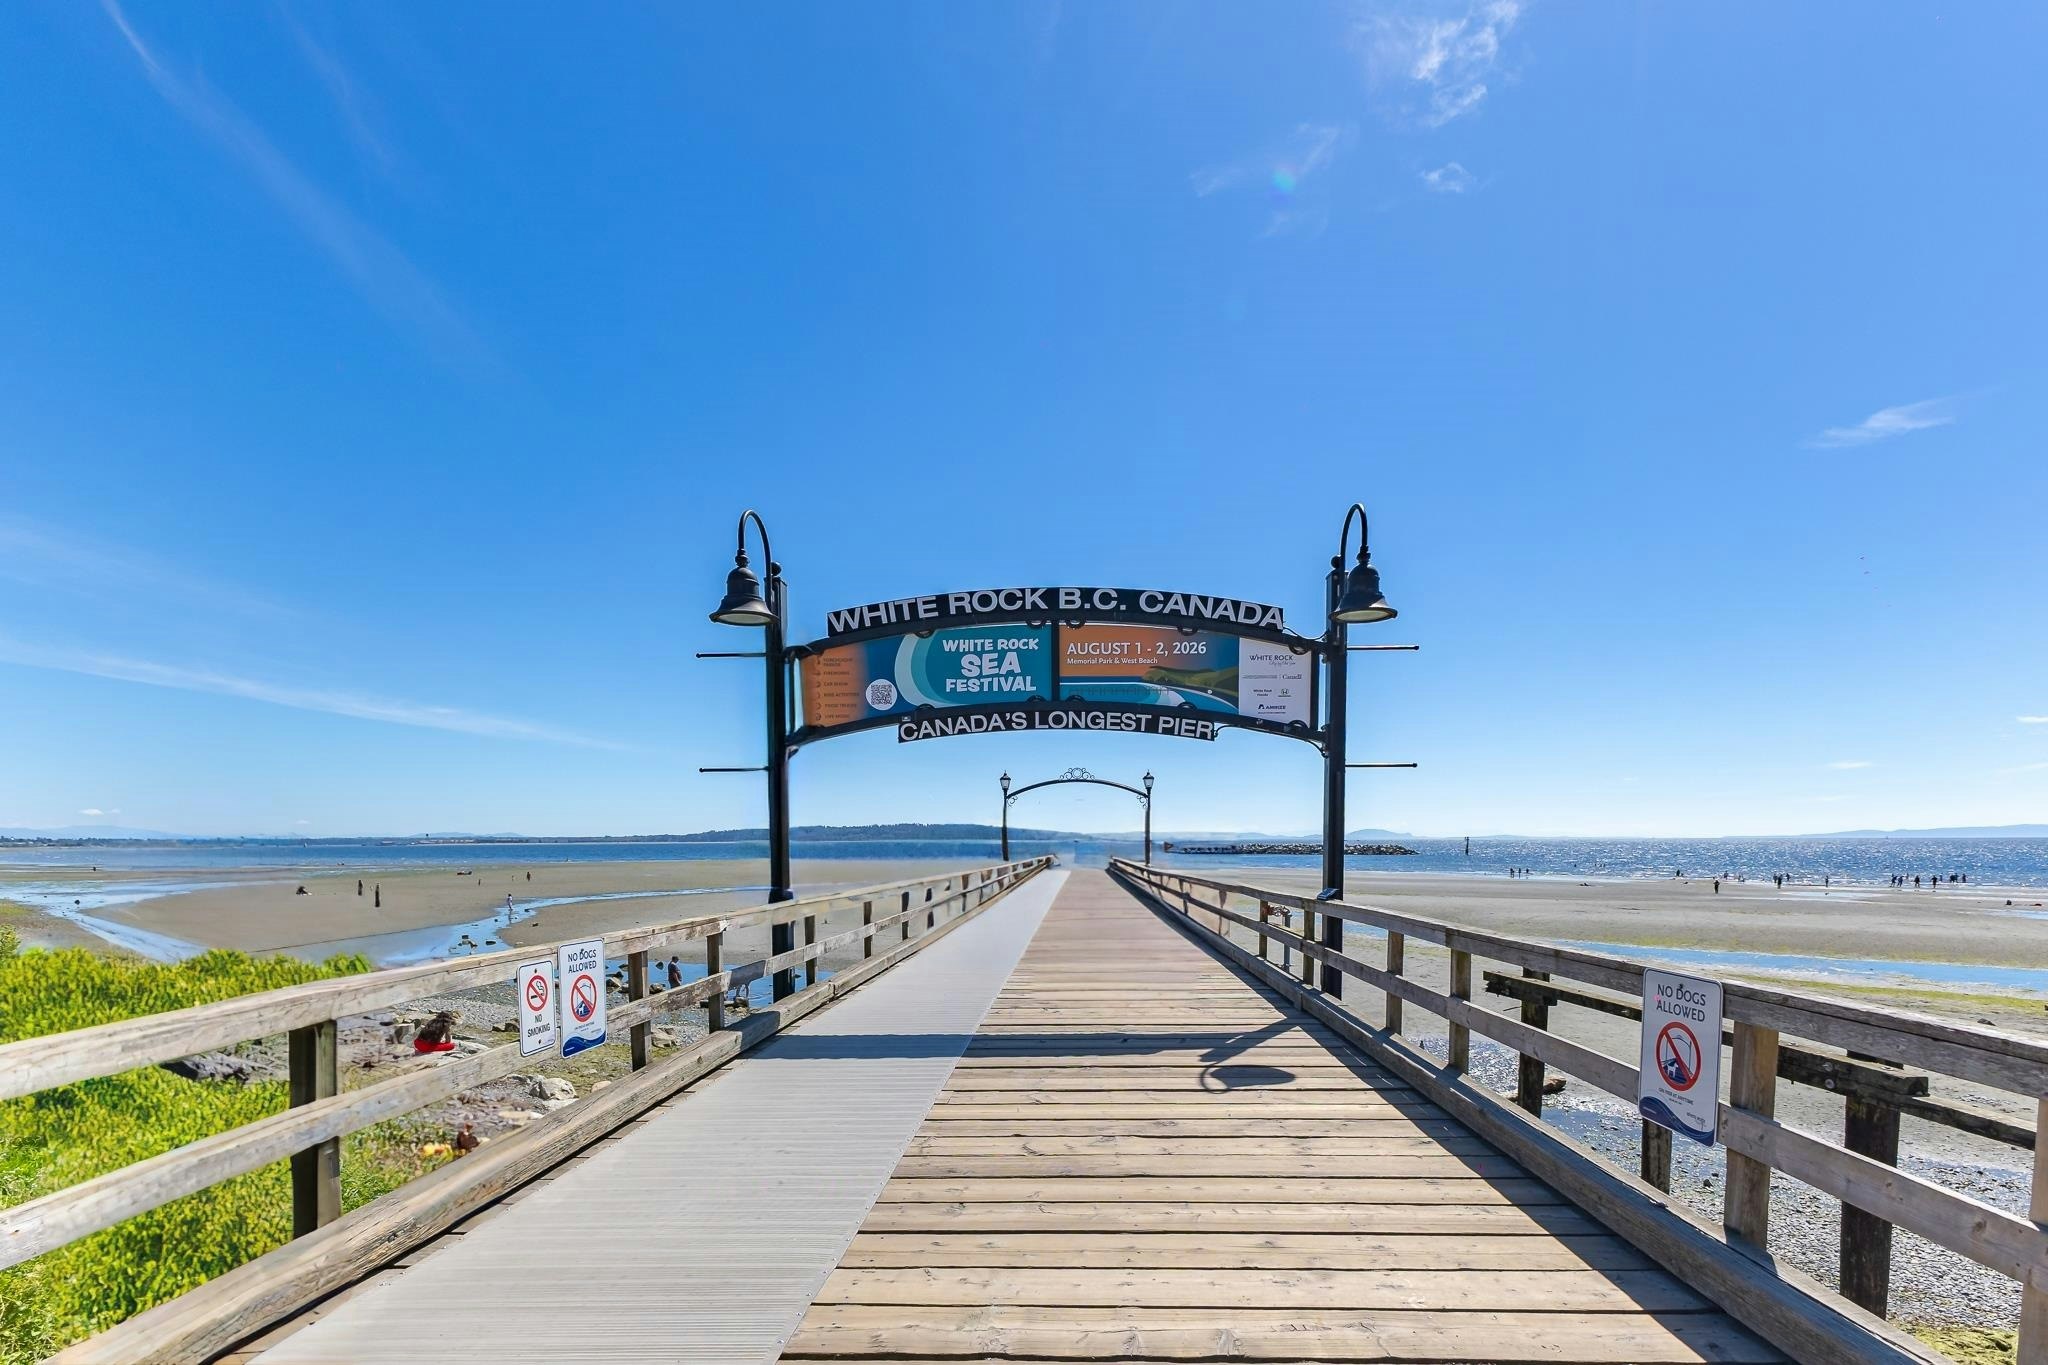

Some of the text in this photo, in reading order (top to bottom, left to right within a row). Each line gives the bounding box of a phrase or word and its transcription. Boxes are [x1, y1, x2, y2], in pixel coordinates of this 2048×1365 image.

[828, 588, 1284, 633] WHITE ROCK B.C. CANADA
[942, 638, 1040, 652] WHITE ROCK
[1066, 642, 1131, 655] AUGUST
[1135, 642, 1141, 654] 1
[1156, 642, 1168, 657] 2,
[1173, 641, 1207, 655] 2026
[961, 652, 1021, 677] SEA
[1066, 657, 1098, 665] Memorial
[1249, 653, 1273, 661] WHITE
[945, 676, 1037, 693] FESTIVAL
[900, 711, 1214, 741] CANADA'S LONGEST PIER
[568, 949, 597, 962] NO DOGS
[568, 960, 597, 974] ALLOWED
[1657, 984, 1706, 1006] NO DOGS
[1656, 999, 1705, 1022] ALLOWED
[535, 1014, 542, 1023] NO
[528, 1023, 550, 1037] SMOKING
